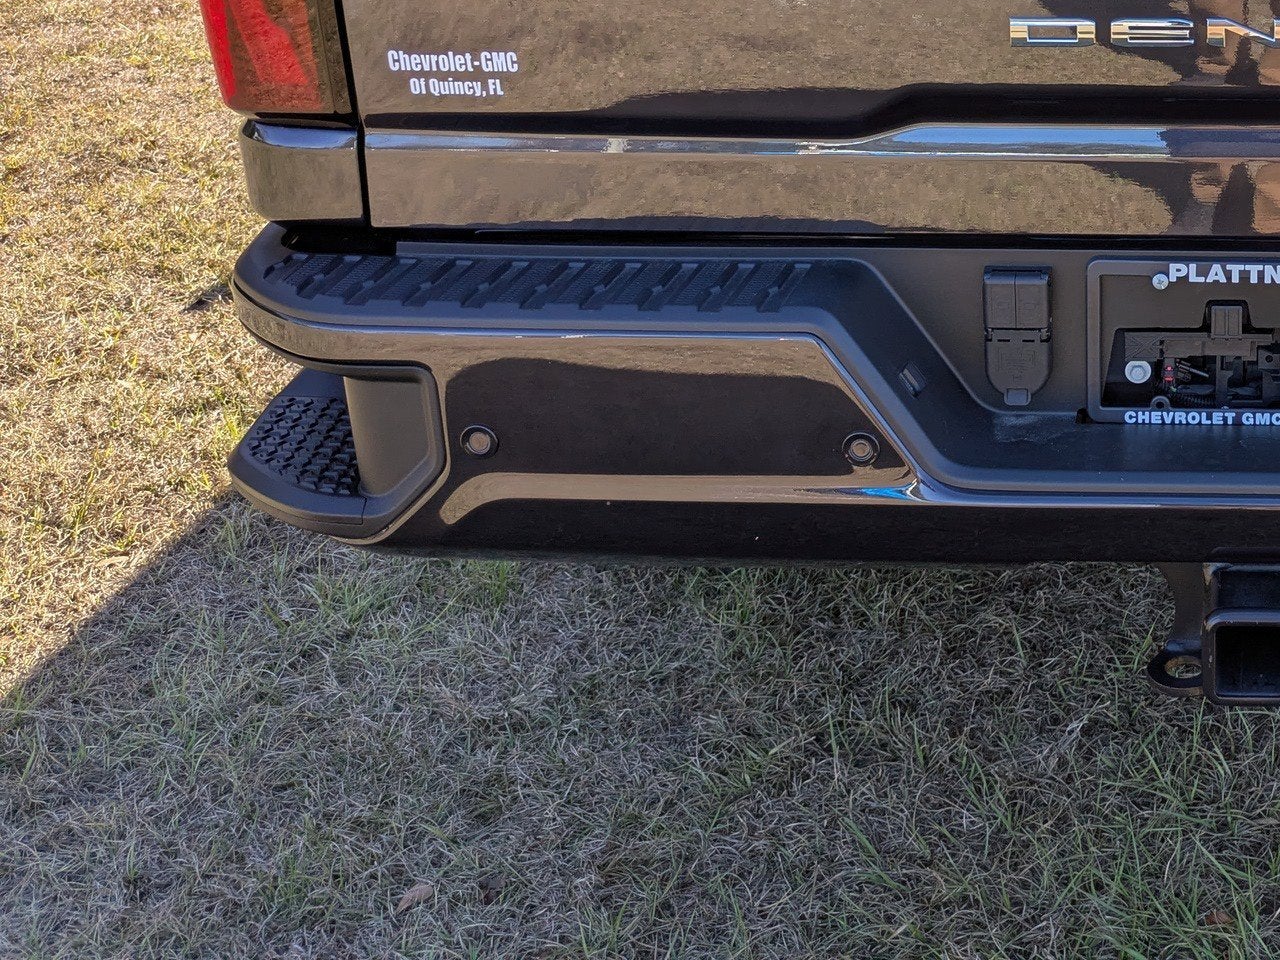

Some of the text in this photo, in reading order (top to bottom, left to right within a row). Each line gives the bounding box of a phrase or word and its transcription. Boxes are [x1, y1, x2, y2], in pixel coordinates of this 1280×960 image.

[387, 50, 518, 72] Chevrolet-GMC
[409, 77, 504, 98] Of Quincy, FL
[1124, 411, 1236, 426] CHEVROLET
